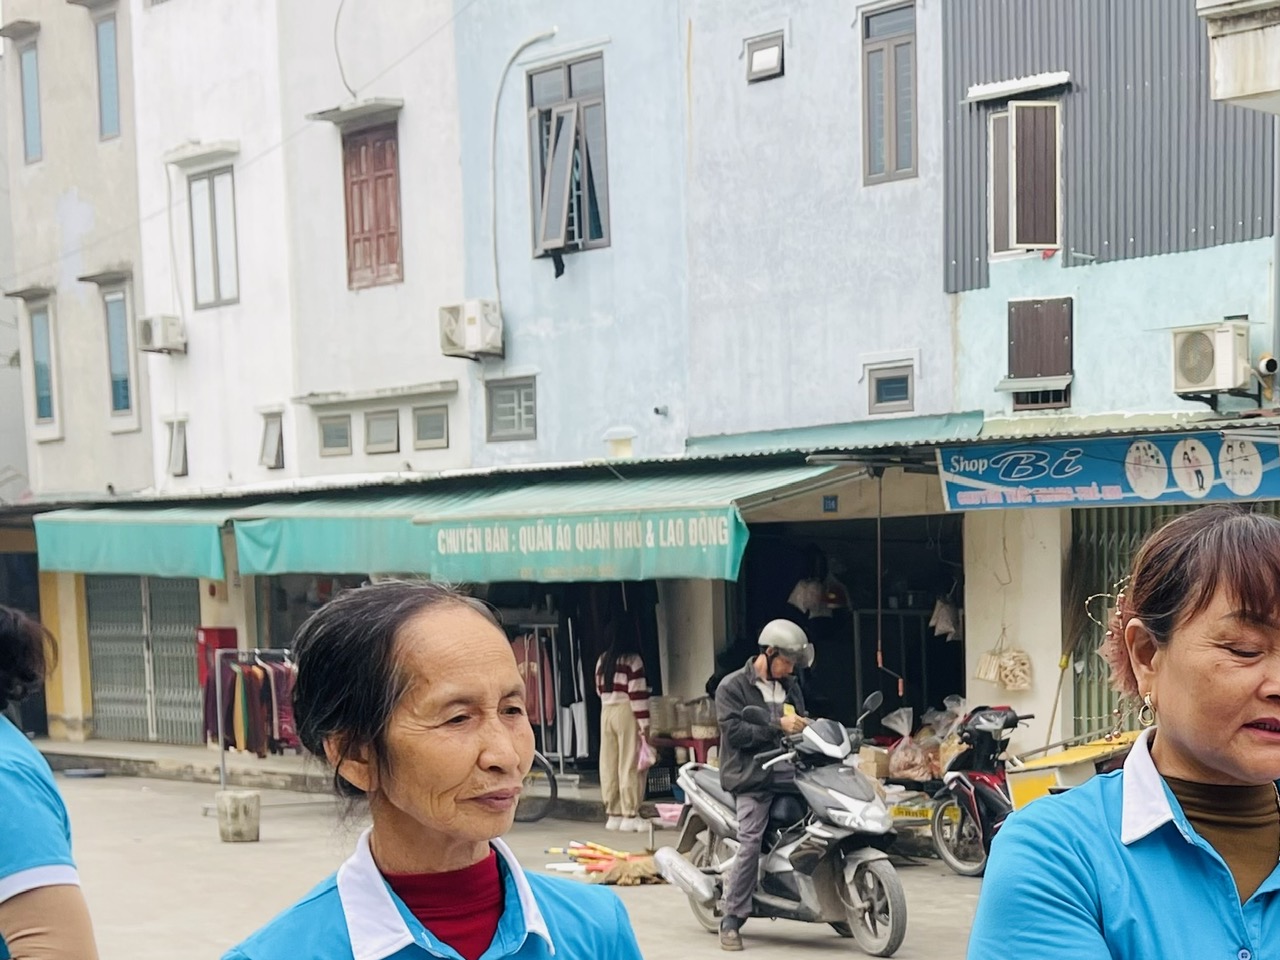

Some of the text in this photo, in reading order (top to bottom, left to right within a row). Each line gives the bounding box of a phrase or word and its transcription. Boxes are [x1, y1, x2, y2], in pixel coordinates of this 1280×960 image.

[950, 447, 1083, 481] Shop Bi
[437, 522, 482, 555] CHUYÊN
[484, 522, 509, 553] BÁN
[556, 518, 571, 552] ÁO
[645, 519, 655, 548] &
[659, 518, 685, 547] LAO
[688, 511, 729, 552] ĐỘNG
